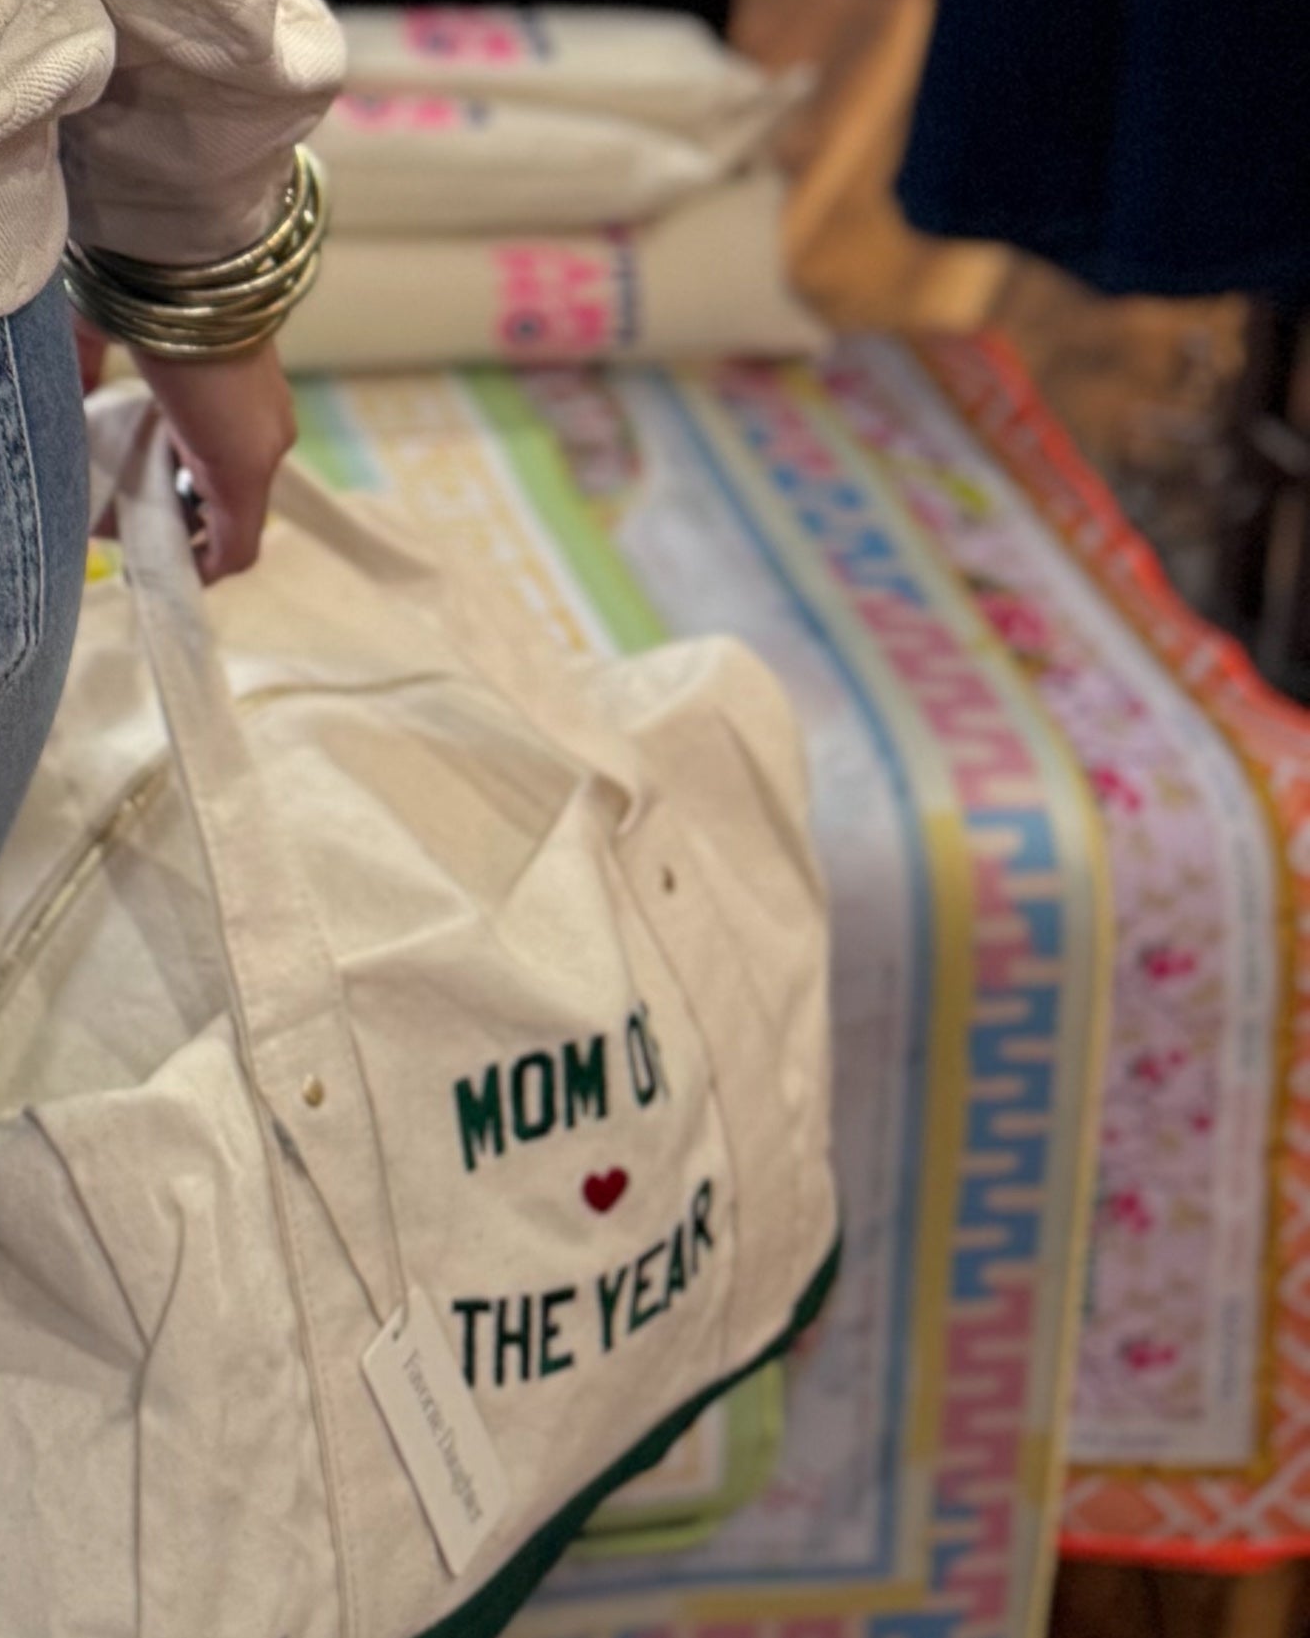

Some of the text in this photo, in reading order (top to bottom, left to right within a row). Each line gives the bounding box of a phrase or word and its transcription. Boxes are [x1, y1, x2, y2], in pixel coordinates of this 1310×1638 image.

[454, 1034, 607, 1173] MOM
[453, 1178, 713, 1387] THE YEAR
